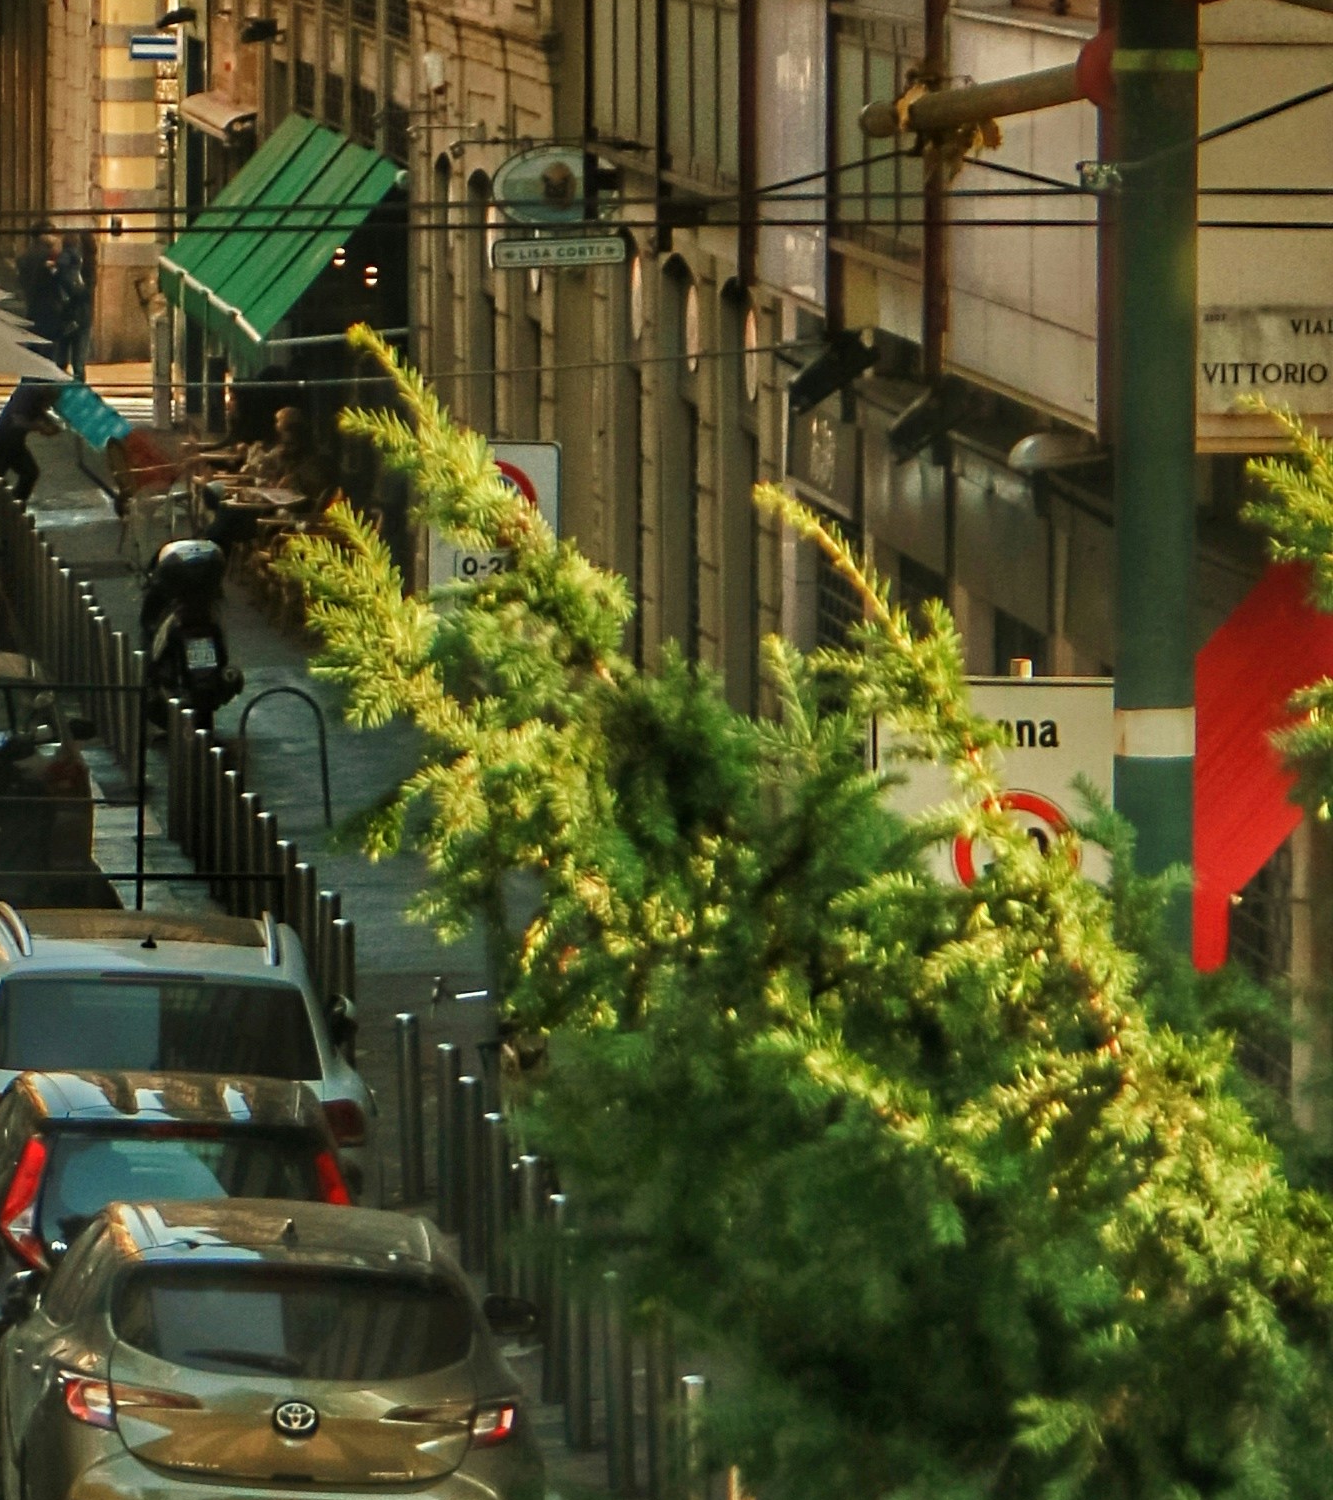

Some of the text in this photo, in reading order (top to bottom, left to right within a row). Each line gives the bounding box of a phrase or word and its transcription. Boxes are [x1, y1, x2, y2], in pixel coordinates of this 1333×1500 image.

[519, 246, 602, 260] LISA CORTI
[1202, 363, 1328, 384] VITTORIO
[461, 556, 504, 576] 0-2
[997, 718, 1060, 748] na
